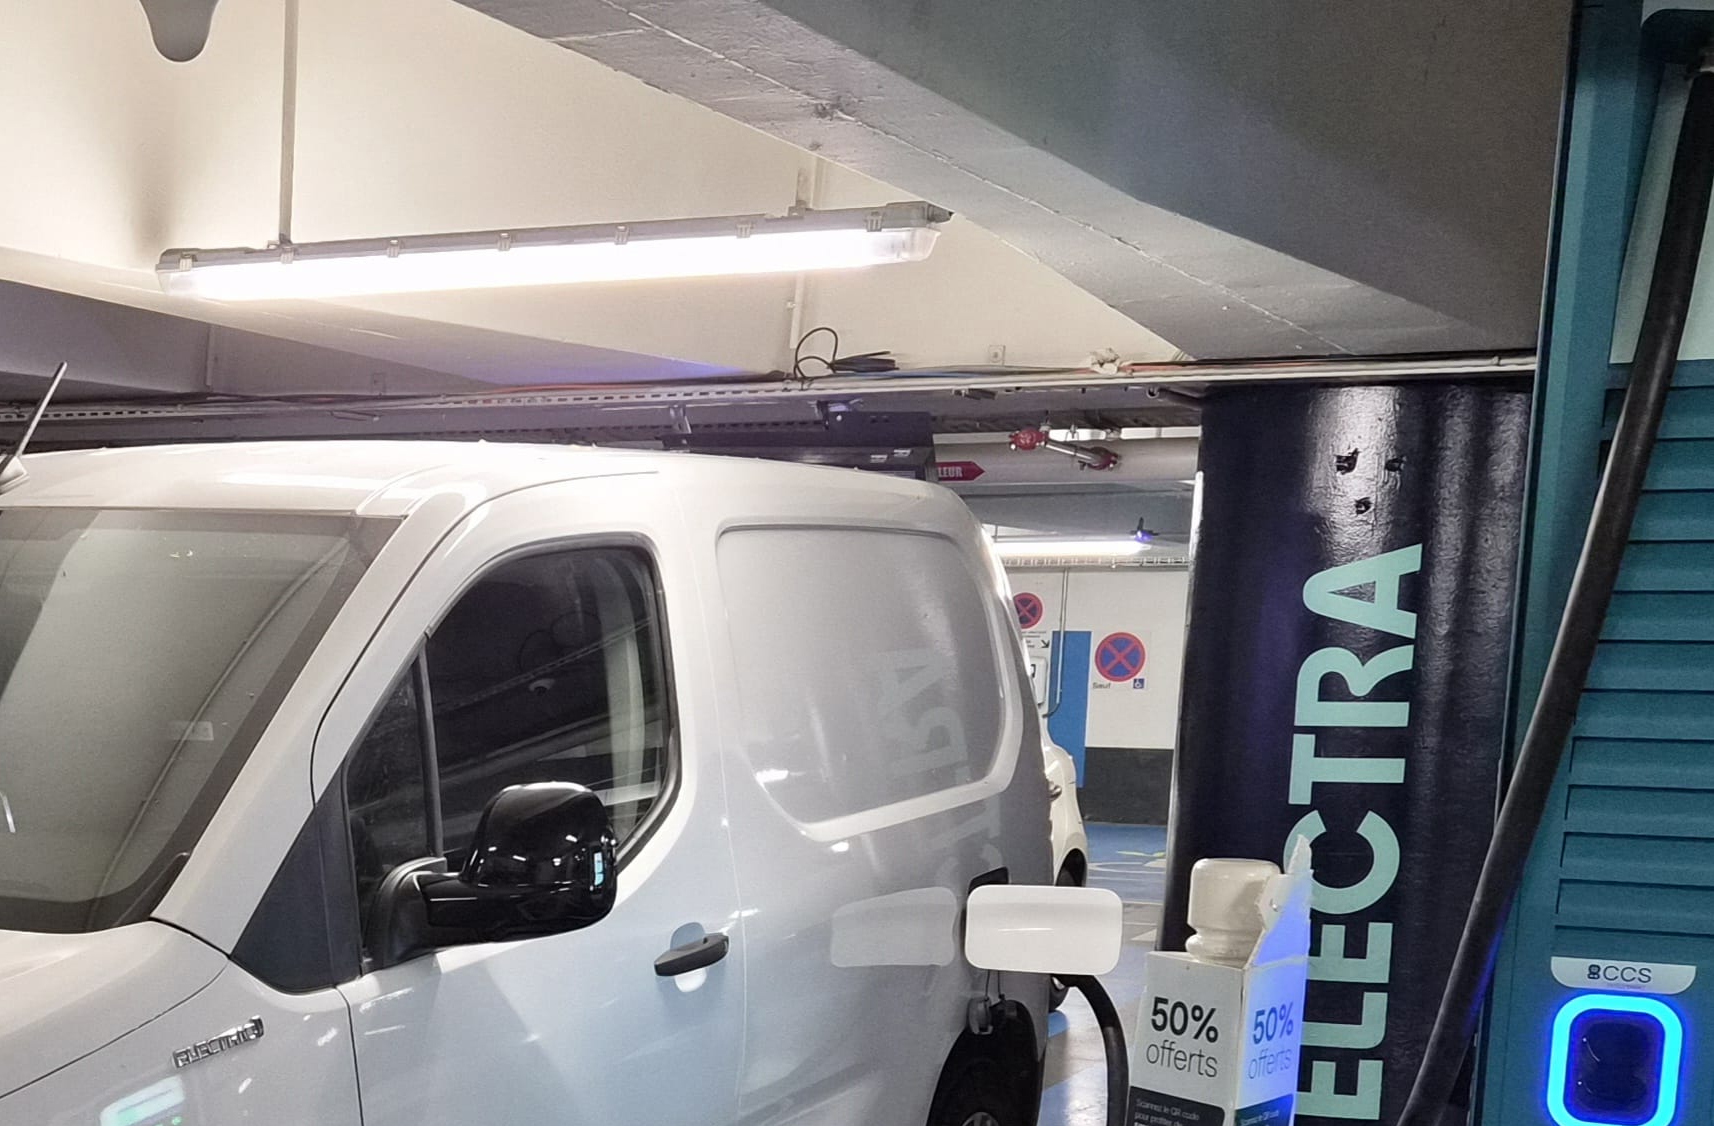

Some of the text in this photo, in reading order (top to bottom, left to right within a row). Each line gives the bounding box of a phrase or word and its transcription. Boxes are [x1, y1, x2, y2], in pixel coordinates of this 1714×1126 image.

[937, 466, 963, 478] LEUR
[1092, 681, 1111, 690] Sauf
[1283, 542, 1423, 1121] ELECTRA
[1603, 965, 1652, 984] CCS
[1151, 996, 1219, 1043] 50%
[1252, 1002, 1294, 1045] 50%
[1146, 1039, 1218, 1078] offerts
[1248, 1047, 1293, 1080] offerts
